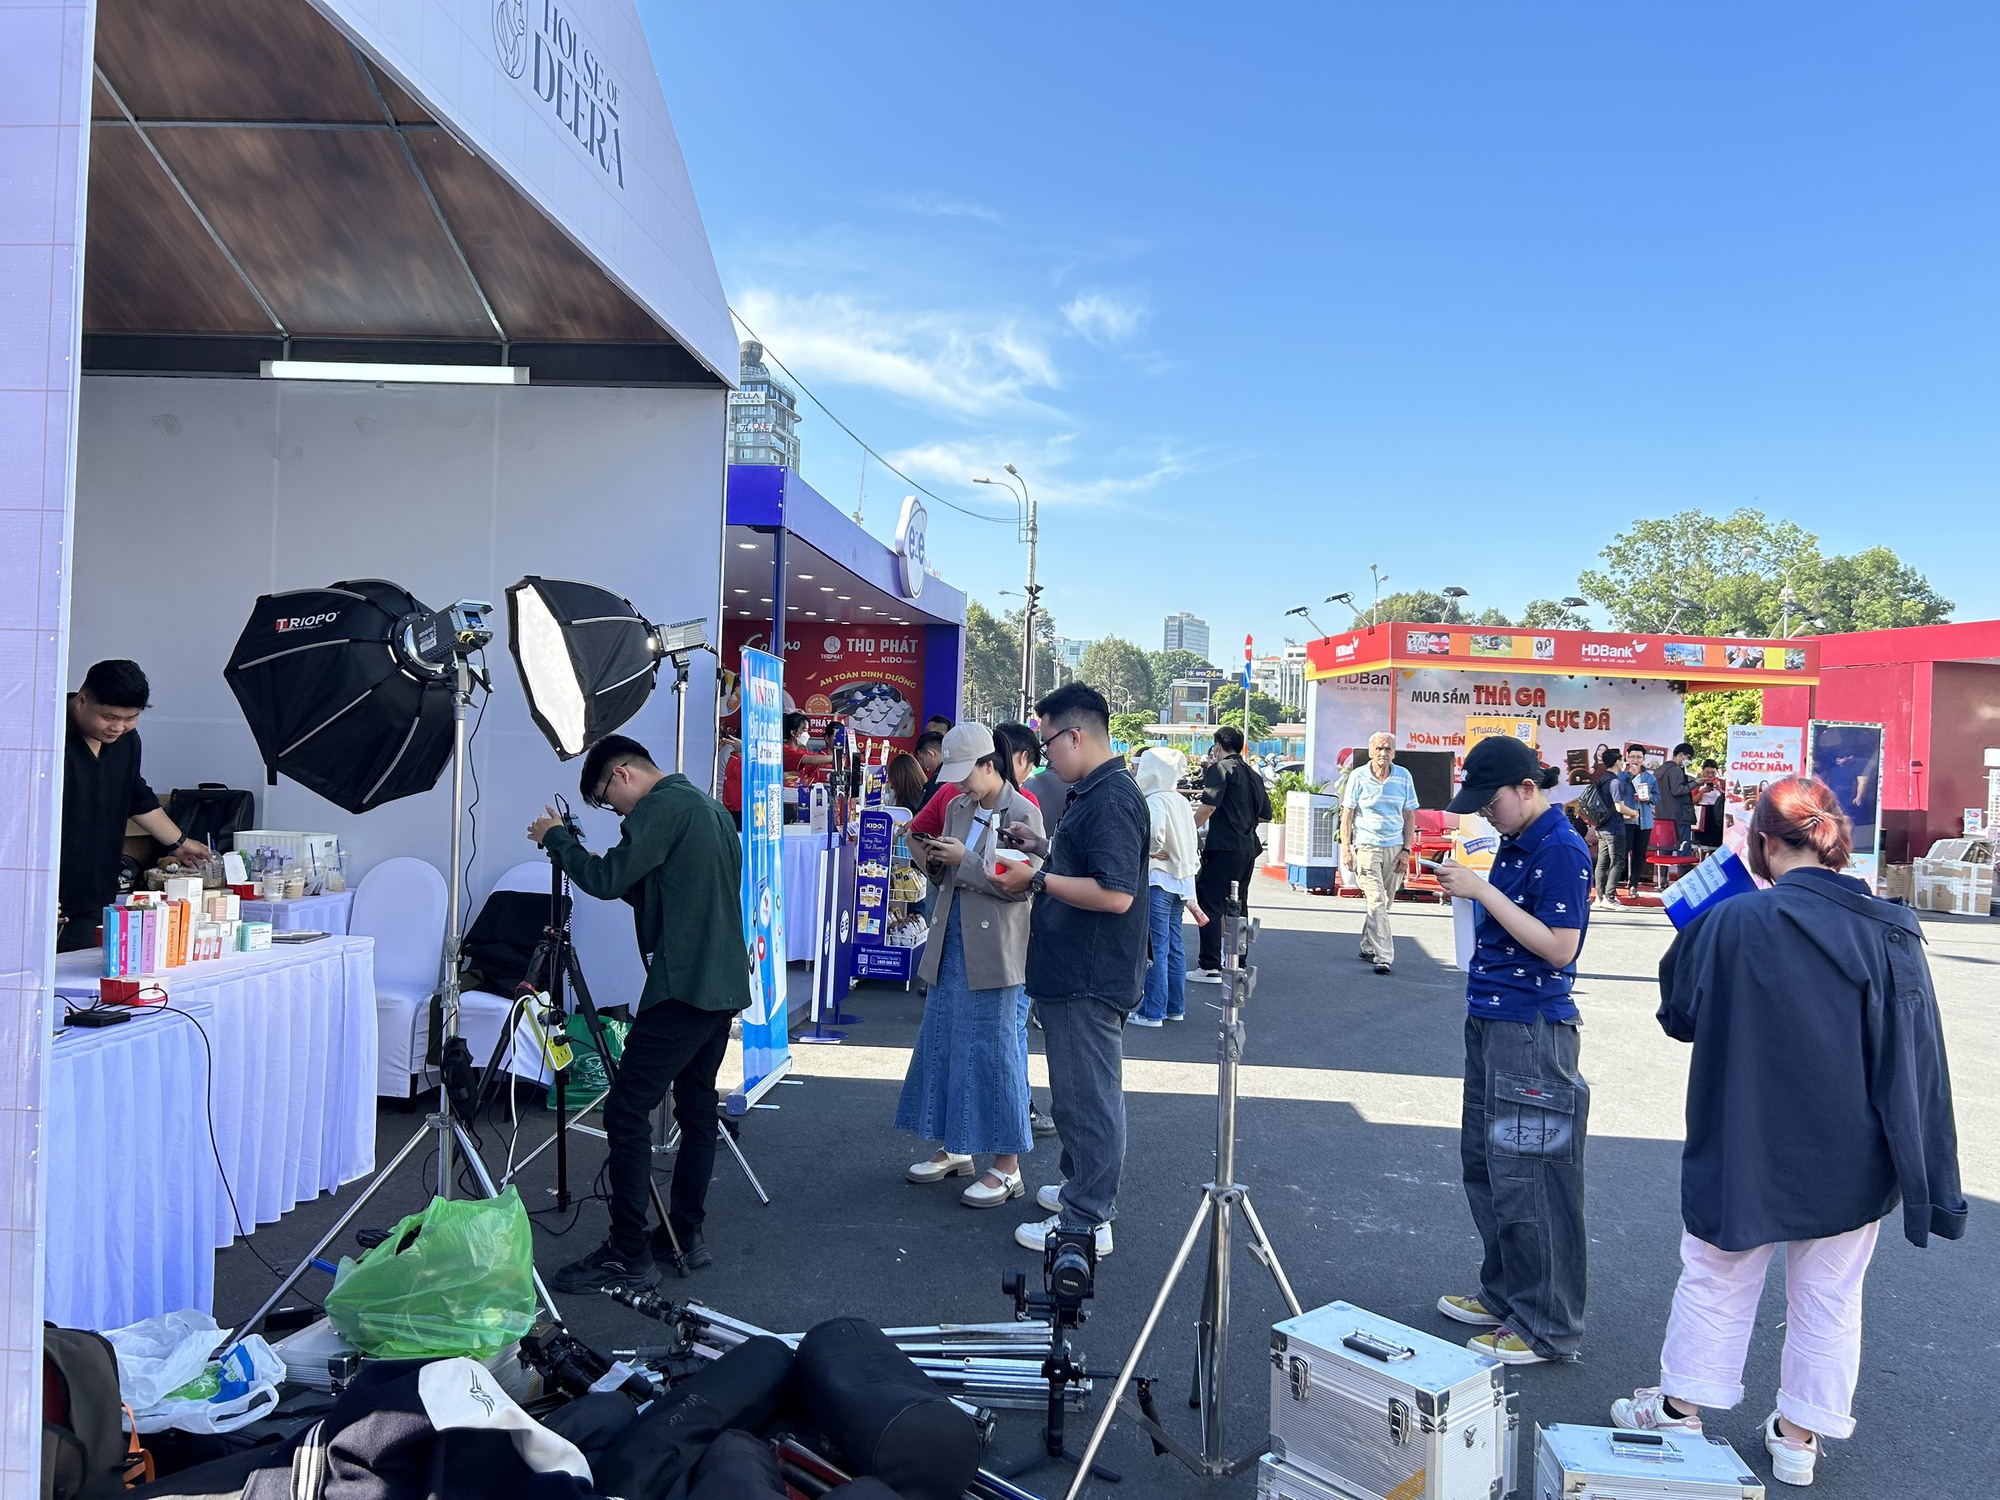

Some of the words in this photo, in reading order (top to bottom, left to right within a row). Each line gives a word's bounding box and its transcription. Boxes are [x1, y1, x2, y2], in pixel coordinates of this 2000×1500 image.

[543, 0, 604, 104] HOUSE
[606, 78, 620, 106] OF
[533, 30, 624, 190] DEERA
[275, 612, 338, 633] TRIOPO
[846, 638, 875, 657] THỌ
[880, 635, 918, 653] PHÁT
[1581, 644, 1633, 658] HDBank
[881, 656, 903, 664] KIDO
[820, 676, 833, 687] AN
[834, 670, 859, 681] TOÀN
[861, 671, 883, 679] DINH
[1205, 670, 1216, 678] 24
[1337, 672, 1399, 686] HDBan
[1411, 690, 1440, 703] MUA
[1442, 687, 1470, 704] SẮM
[1473, 680, 1512, 706] THẢ
[1514, 686, 1546, 708] GA
[1545, 709, 1580, 733] CỰC
[1584, 707, 1611, 731] ĐÃ
[1409, 732, 1440, 746] HOÀN
[1741, 751, 1765, 759] DEAL
[1731, 758, 1766, 771] CHỐT
[1766, 760, 1794, 772] NĂM
